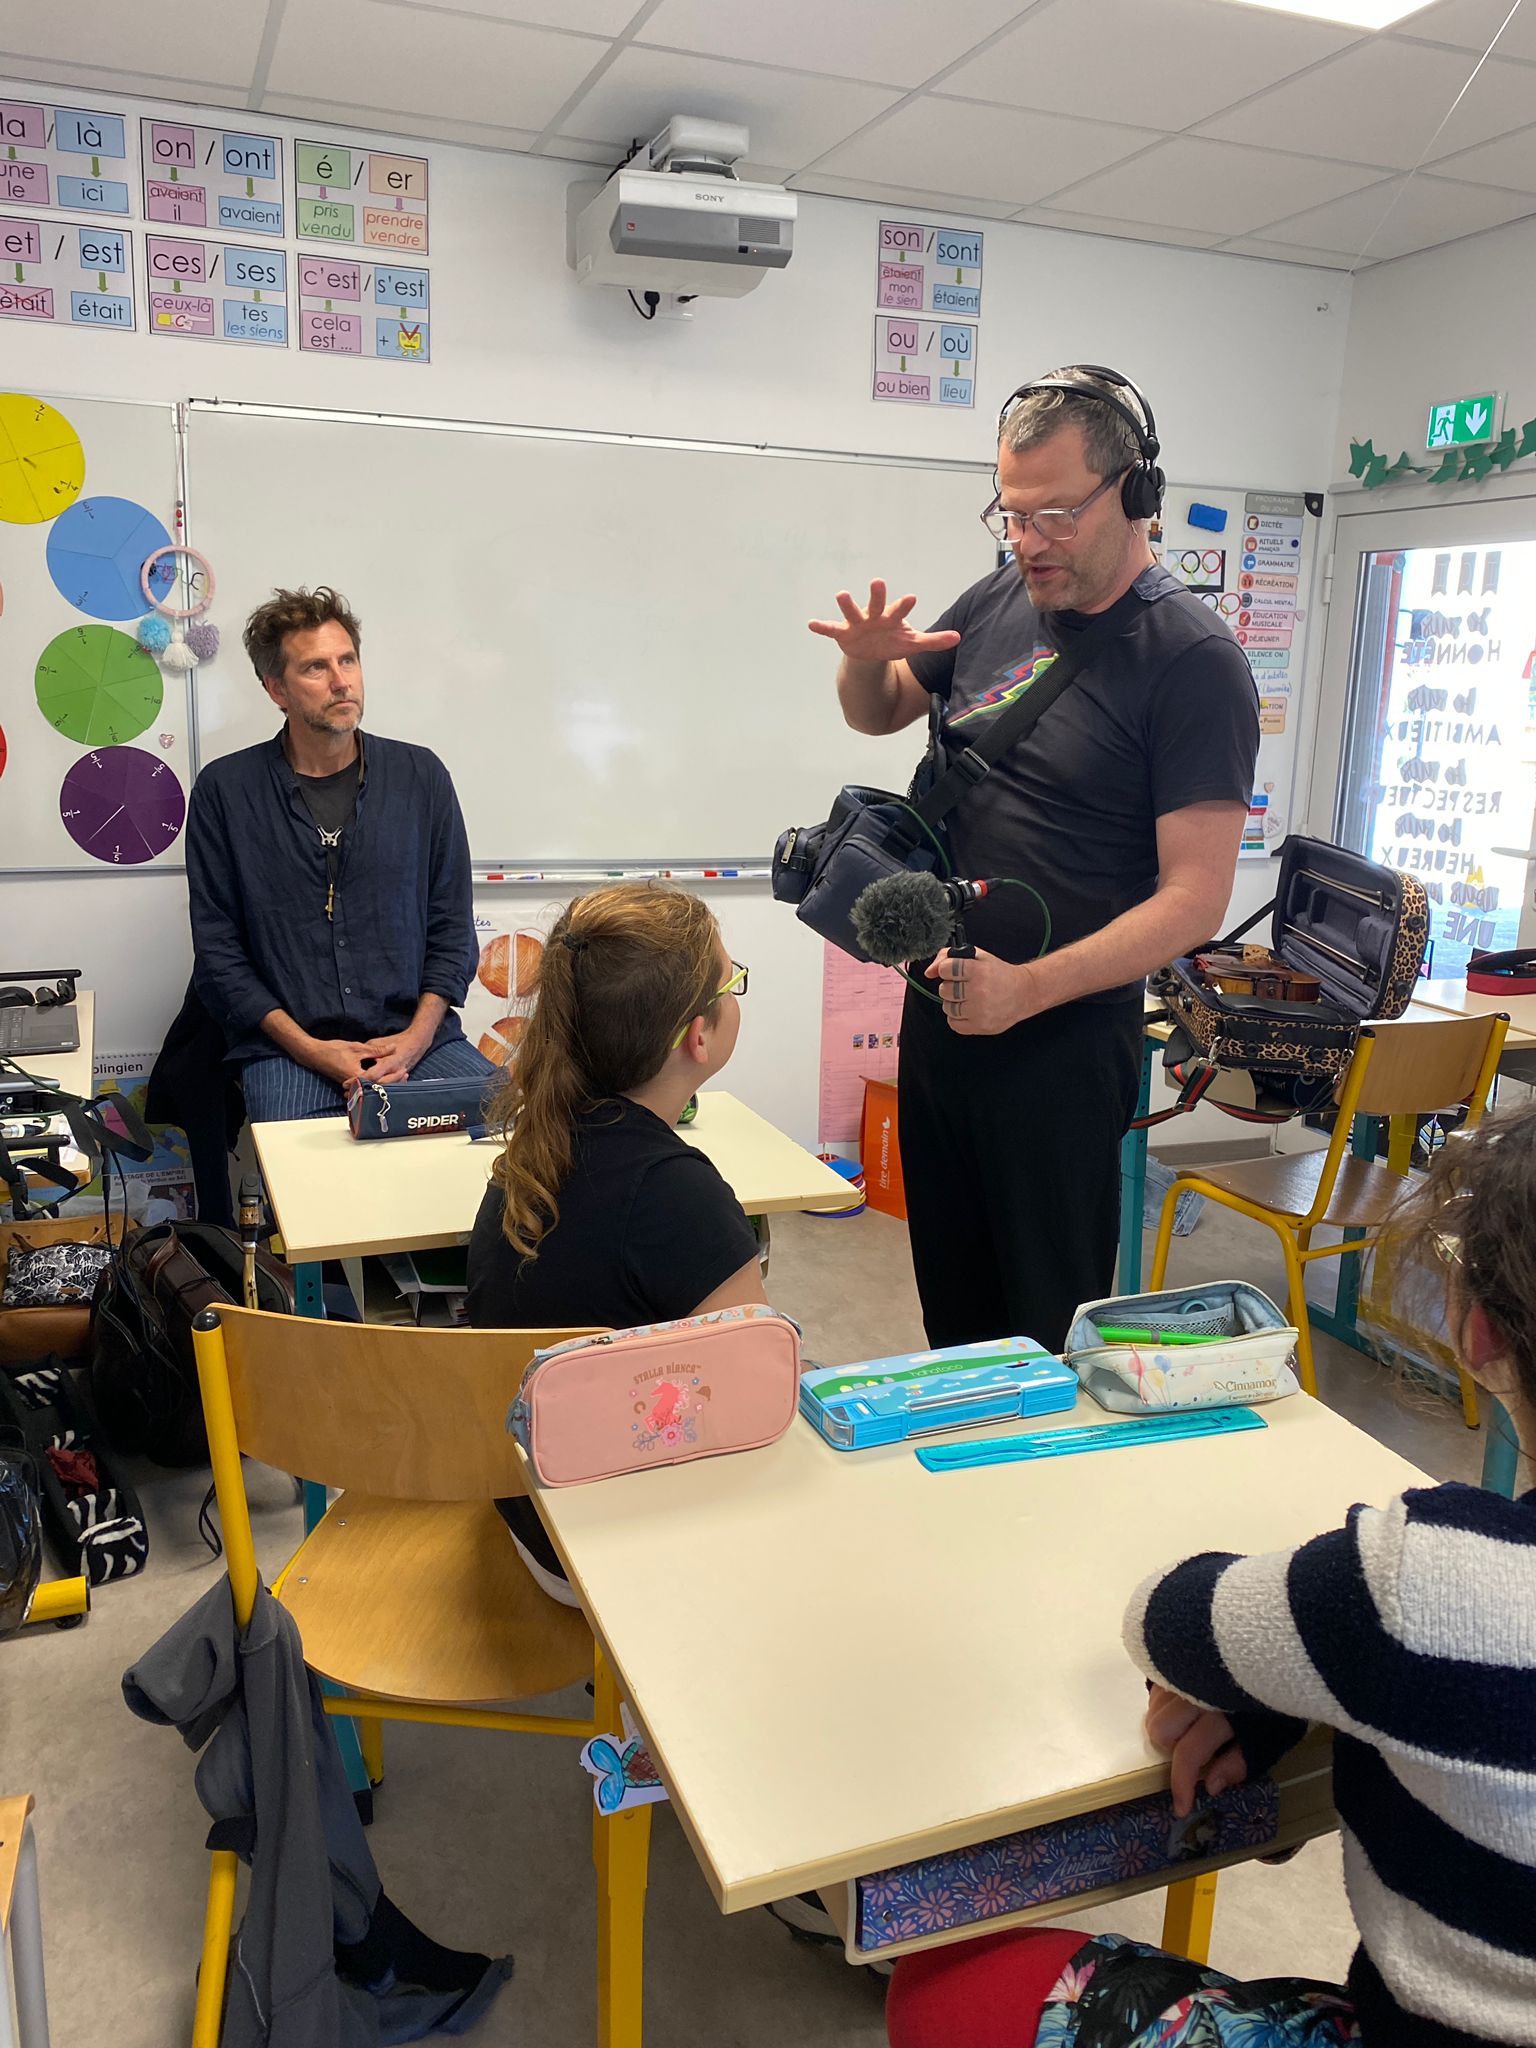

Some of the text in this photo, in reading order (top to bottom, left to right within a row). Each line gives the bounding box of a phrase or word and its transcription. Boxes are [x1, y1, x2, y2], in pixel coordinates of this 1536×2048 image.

[0, 111, 26, 138] la
[76, 121, 102, 148] là
[155, 138, 192, 160] on
[225, 148, 271, 170] ont
[316, 154, 333, 179] é
[387, 171, 413, 190] er
[8, 180, 25, 198] le
[81, 182, 104, 202] ici
[150, 186, 203, 201] avaient
[695, 193, 725, 203] SONY
[173, 204, 181, 222] il
[220, 206, 281, 225] avaient
[313, 204, 339, 219] pris
[366, 211, 424, 230] prendre
[302, 220, 351, 239] vendu
[370, 229, 421, 246] vendre
[5, 231, 34, 255] et
[82, 242, 122, 265] est
[884, 229, 920, 248] son
[937, 243, 980, 263] sont
[153, 253, 201, 275] ces
[236, 262, 277, 284] ses
[883, 267, 921, 282] étaient
[303, 267, 359, 290] c'est
[377, 276, 425, 298] s'est
[889, 282, 914, 294] mon
[0, 293, 46, 314] était
[152, 296, 211, 313] ceux-là
[883, 294, 918, 307] le sien
[934, 289, 978, 308] étaient
[78, 299, 124, 321] était
[242, 304, 268, 322] tes
[227, 321, 284, 340] les siens
[311, 316, 351, 332] cela
[310, 334, 337, 349] est
[889, 332, 915, 349] ou
[943, 333, 968, 354] où
[876, 379, 929, 397] ou bien
[943, 384, 968, 400] lieu
[1260, 520, 1284, 529] DICTÉE
[1257, 559, 1296, 569] GRAMMAIRE
[1255, 578, 1295, 589] RÉCRÉATION
[1252, 610, 1289, 620] ÉDUCATION
[1248, 633, 1280, 643] DÉJEUNER
[407, 1114, 459, 1129] SPIDER
